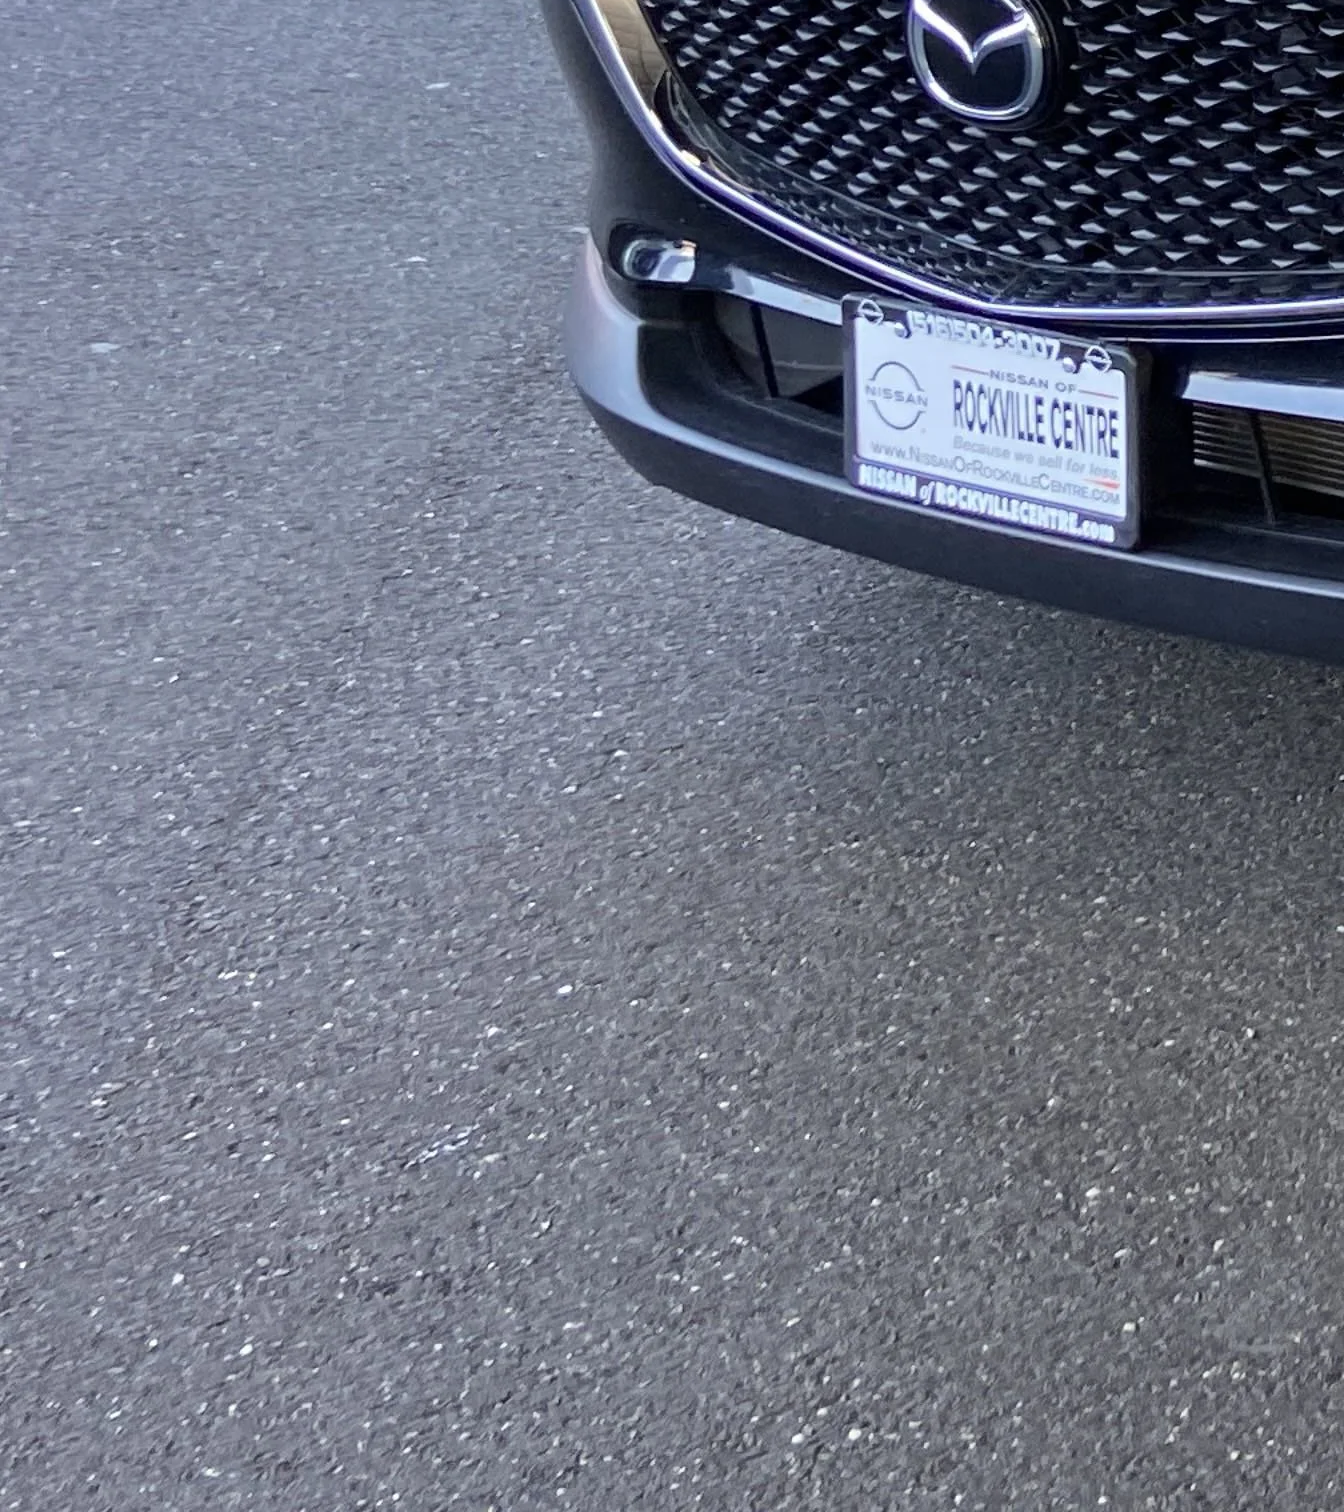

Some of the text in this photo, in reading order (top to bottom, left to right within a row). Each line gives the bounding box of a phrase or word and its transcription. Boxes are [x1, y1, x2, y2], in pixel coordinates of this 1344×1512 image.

[989, 368, 1078, 396] NISSAN OF
[865, 384, 929, 408] NISSAN
[952, 378, 1120, 459] ROCKVILLE CENTRE
[952, 435, 1011, 459] Because
